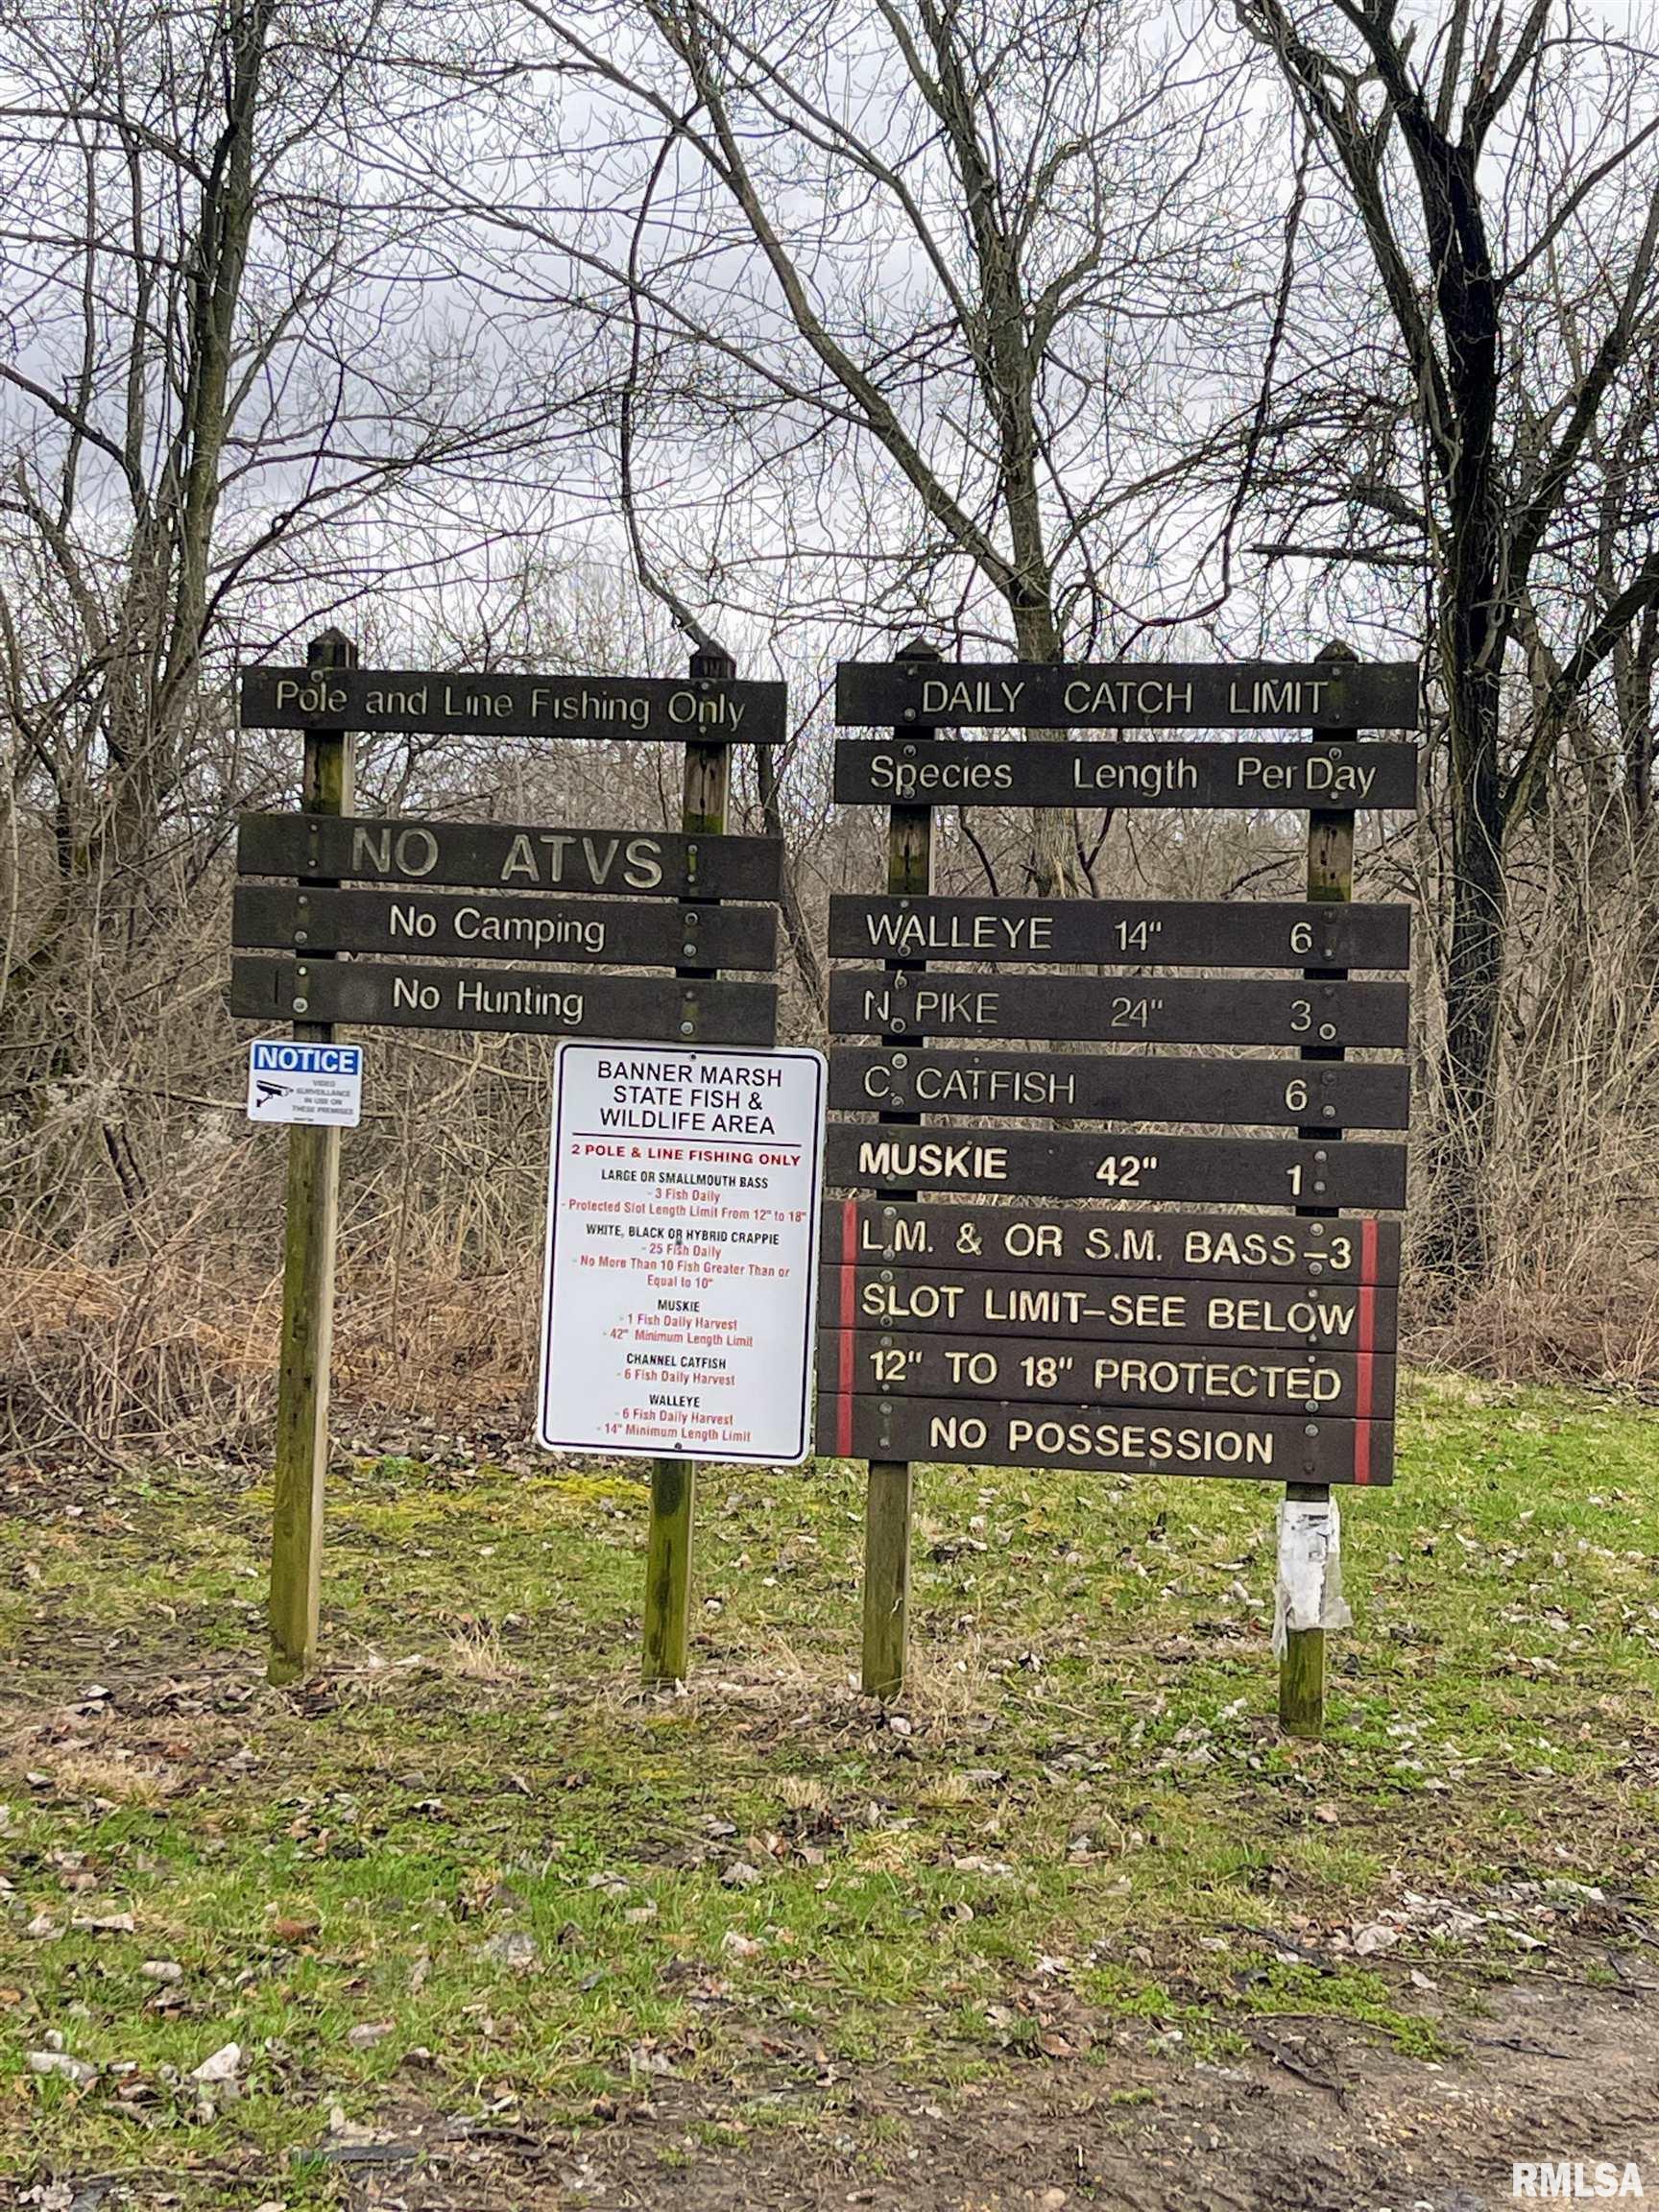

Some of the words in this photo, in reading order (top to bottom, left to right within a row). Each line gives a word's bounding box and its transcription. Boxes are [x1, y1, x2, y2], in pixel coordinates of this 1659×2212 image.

[276, 681, 347, 712] Pole
[366, 685, 427, 716] and
[444, 685, 513, 718] Line
[532, 687, 650, 729] Fishing
[668, 692, 744, 733] Only
[922, 680, 1024, 713] DAILY
[1063, 681, 1192, 714] CATCH
[1230, 681, 1330, 714] LIMIT
[870, 755, 1014, 798] Species
[1074, 757, 1198, 798] Length
[1237, 757, 1298, 789] Per
[1307, 757, 1376, 797] Day
[352, 827, 438, 877] NO
[500, 833, 662, 889] ATVS
[390, 905, 437, 937] No
[454, 907, 606, 953] Camping
[866, 915, 1054, 950] WALLEYE
[1115, 920, 1162, 950] 14"
[1290, 923, 1311, 953] 6
[393, 977, 441, 1010] No
[458, 981, 583, 1025] Hunting
[916, 992, 999, 1023] PIKE
[1110, 997, 1163, 1028] 24"
[1290, 1000, 1310, 1031] 3
[257, 1046, 354, 1073] NOTICE
[598, 1061, 692, 1083] BANNER
[701, 1066, 781, 1087] MARSH
[613, 1086, 683, 1106] STATE
[690, 1089, 739, 1110] FISH
[748, 1092, 763, 1111] &
[916, 1068, 1074, 1104] CATFISH
[1286, 1080, 1307, 1111] 6
[600, 1108, 705, 1131] WILDLIFE
[711, 1115, 775, 1135] AREA
[571, 1144, 580, 1155] 2
[585, 1144, 625, 1158] POLE
[631, 1147, 641, 1158] &
[648, 1147, 683, 1161] LINE
[689, 1149, 754, 1165] FISHING
[759, 1153, 802, 1166] ONLY
[601, 1168, 637, 1183] LARGE
[640, 1170, 655, 1184] OR
[658, 1172, 736, 1188] SMALLMOUTH
[739, 1175, 769, 1190] BASS
[859, 1142, 1007, 1180] MUSKIE
[1095, 1156, 1158, 1187] 42"
[1286, 1165, 1301, 1194] 1
[655, 1188, 662, 1199] 3
[665, 1188, 688, 1201] Fish
[692, 1190, 721, 1205] Daily
[568, 1198, 620, 1214] Protected
[624, 1201, 646, 1214] Slot
[649, 1203, 686, 1218] Length
[689, 1206, 718, 1219] Limit
[722, 1207, 750, 1220] From
[774, 1212, 785, 1222] to
[586, 1223, 625, 1238] WHITE,
[628, 1225, 664, 1239] BLACK
[668, 1228, 683, 1240] OR
[685, 1229, 728, 1242] HYBRID
[731, 1232, 780, 1245] CRAPPIE
[863, 1219, 933, 1252] L.M.
[956, 1222, 982, 1256] &
[1005, 1223, 1063, 1257] OR
[1085, 1228, 1163, 1262] S.M.
[649, 1243, 663, 1255] 25
[666, 1243, 689, 1256] Fish
[693, 1245, 722, 1260] Daily
[580, 1255, 595, 1267] No
[599, 1257, 626, 1268] More
[631, 1258, 658, 1270] Than
[661, 1260, 673, 1271] 10
[677, 1260, 700, 1273] Fish
[704, 1262, 744, 1275] Greater
[748, 1264, 775, 1277] Than
[778, 1267, 790, 1278] or
[647, 1274, 677, 1289] Equal
[681, 1277, 691, 1287] to
[658, 1299, 700, 1312] MUSKIE
[862, 1282, 964, 1318] SLOT
[1208, 1297, 1357, 1335] BELOW
[628, 1313, 633, 1325] 1
[637, 1314, 661, 1326] Fish
[663, 1316, 692, 1330] Daily
[695, 1318, 738, 1331] Harvest
[635, 1330, 683, 1343] Minimum
[686, 1333, 723, 1347] Length
[726, 1335, 753, 1348] Limit
[626, 1353, 677, 1367] CHANNEL
[681, 1356, 727, 1369] CATFISH
[624, 1368, 632, 1380] 6
[635, 1369, 658, 1382] Fish
[661, 1371, 689, 1385] Daily
[693, 1373, 735, 1386] Harvest
[870, 1350, 924, 1382] 12"
[945, 1353, 998, 1384] TO
[1020, 1356, 1073, 1388] 18"
[1094, 1358, 1341, 1401] PROTECTED
[649, 1394, 700, 1408] WALLEYE
[622, 1408, 629, 1419] 6
[633, 1409, 656, 1421] Fish
[660, 1410, 688, 1425] Daily
[691, 1413, 733, 1426] Harvest
[625, 1425, 677, 1438] Minimum
[681, 1428, 718, 1442] Length
[722, 1429, 752, 1442] Limit
[930, 1417, 987, 1450] NO
[1009, 1420, 1274, 1463] POSSESSION
